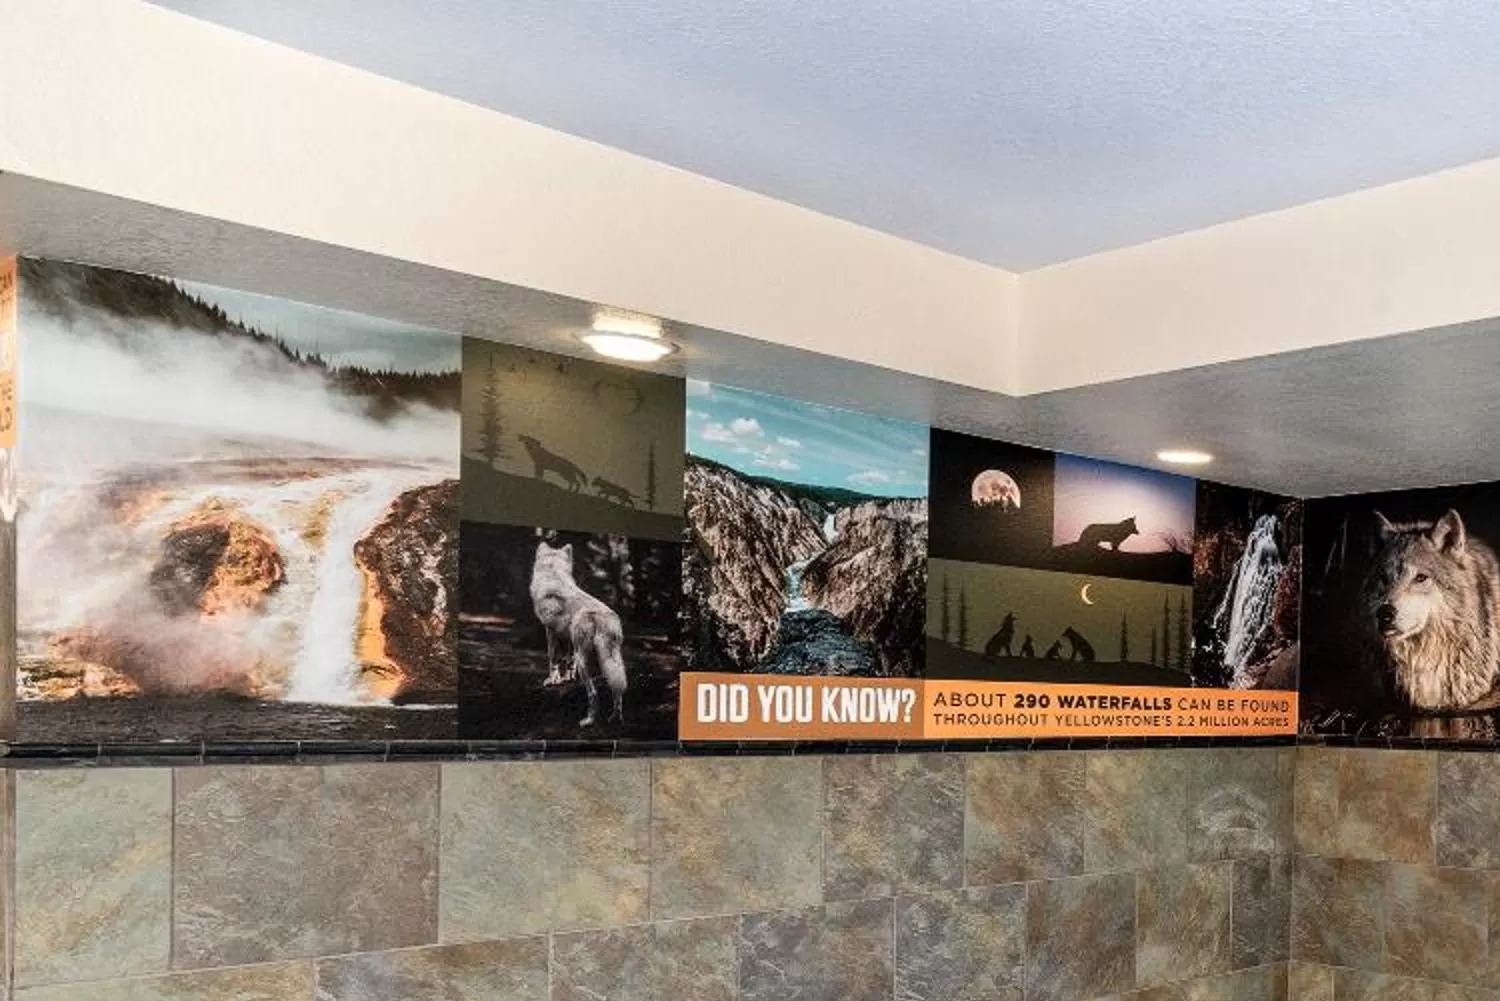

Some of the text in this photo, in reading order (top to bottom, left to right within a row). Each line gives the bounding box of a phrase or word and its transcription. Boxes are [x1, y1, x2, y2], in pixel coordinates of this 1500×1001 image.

[697, 683, 918, 724] DID YOU KNOW?
[933, 692, 1290, 713] ABOUT 290 WATERFALLS CAN BE FOUND
[933, 713, 1289, 728] THROUGHOUT YELLOWSTONE'S 2.2 MILLION ACRES
